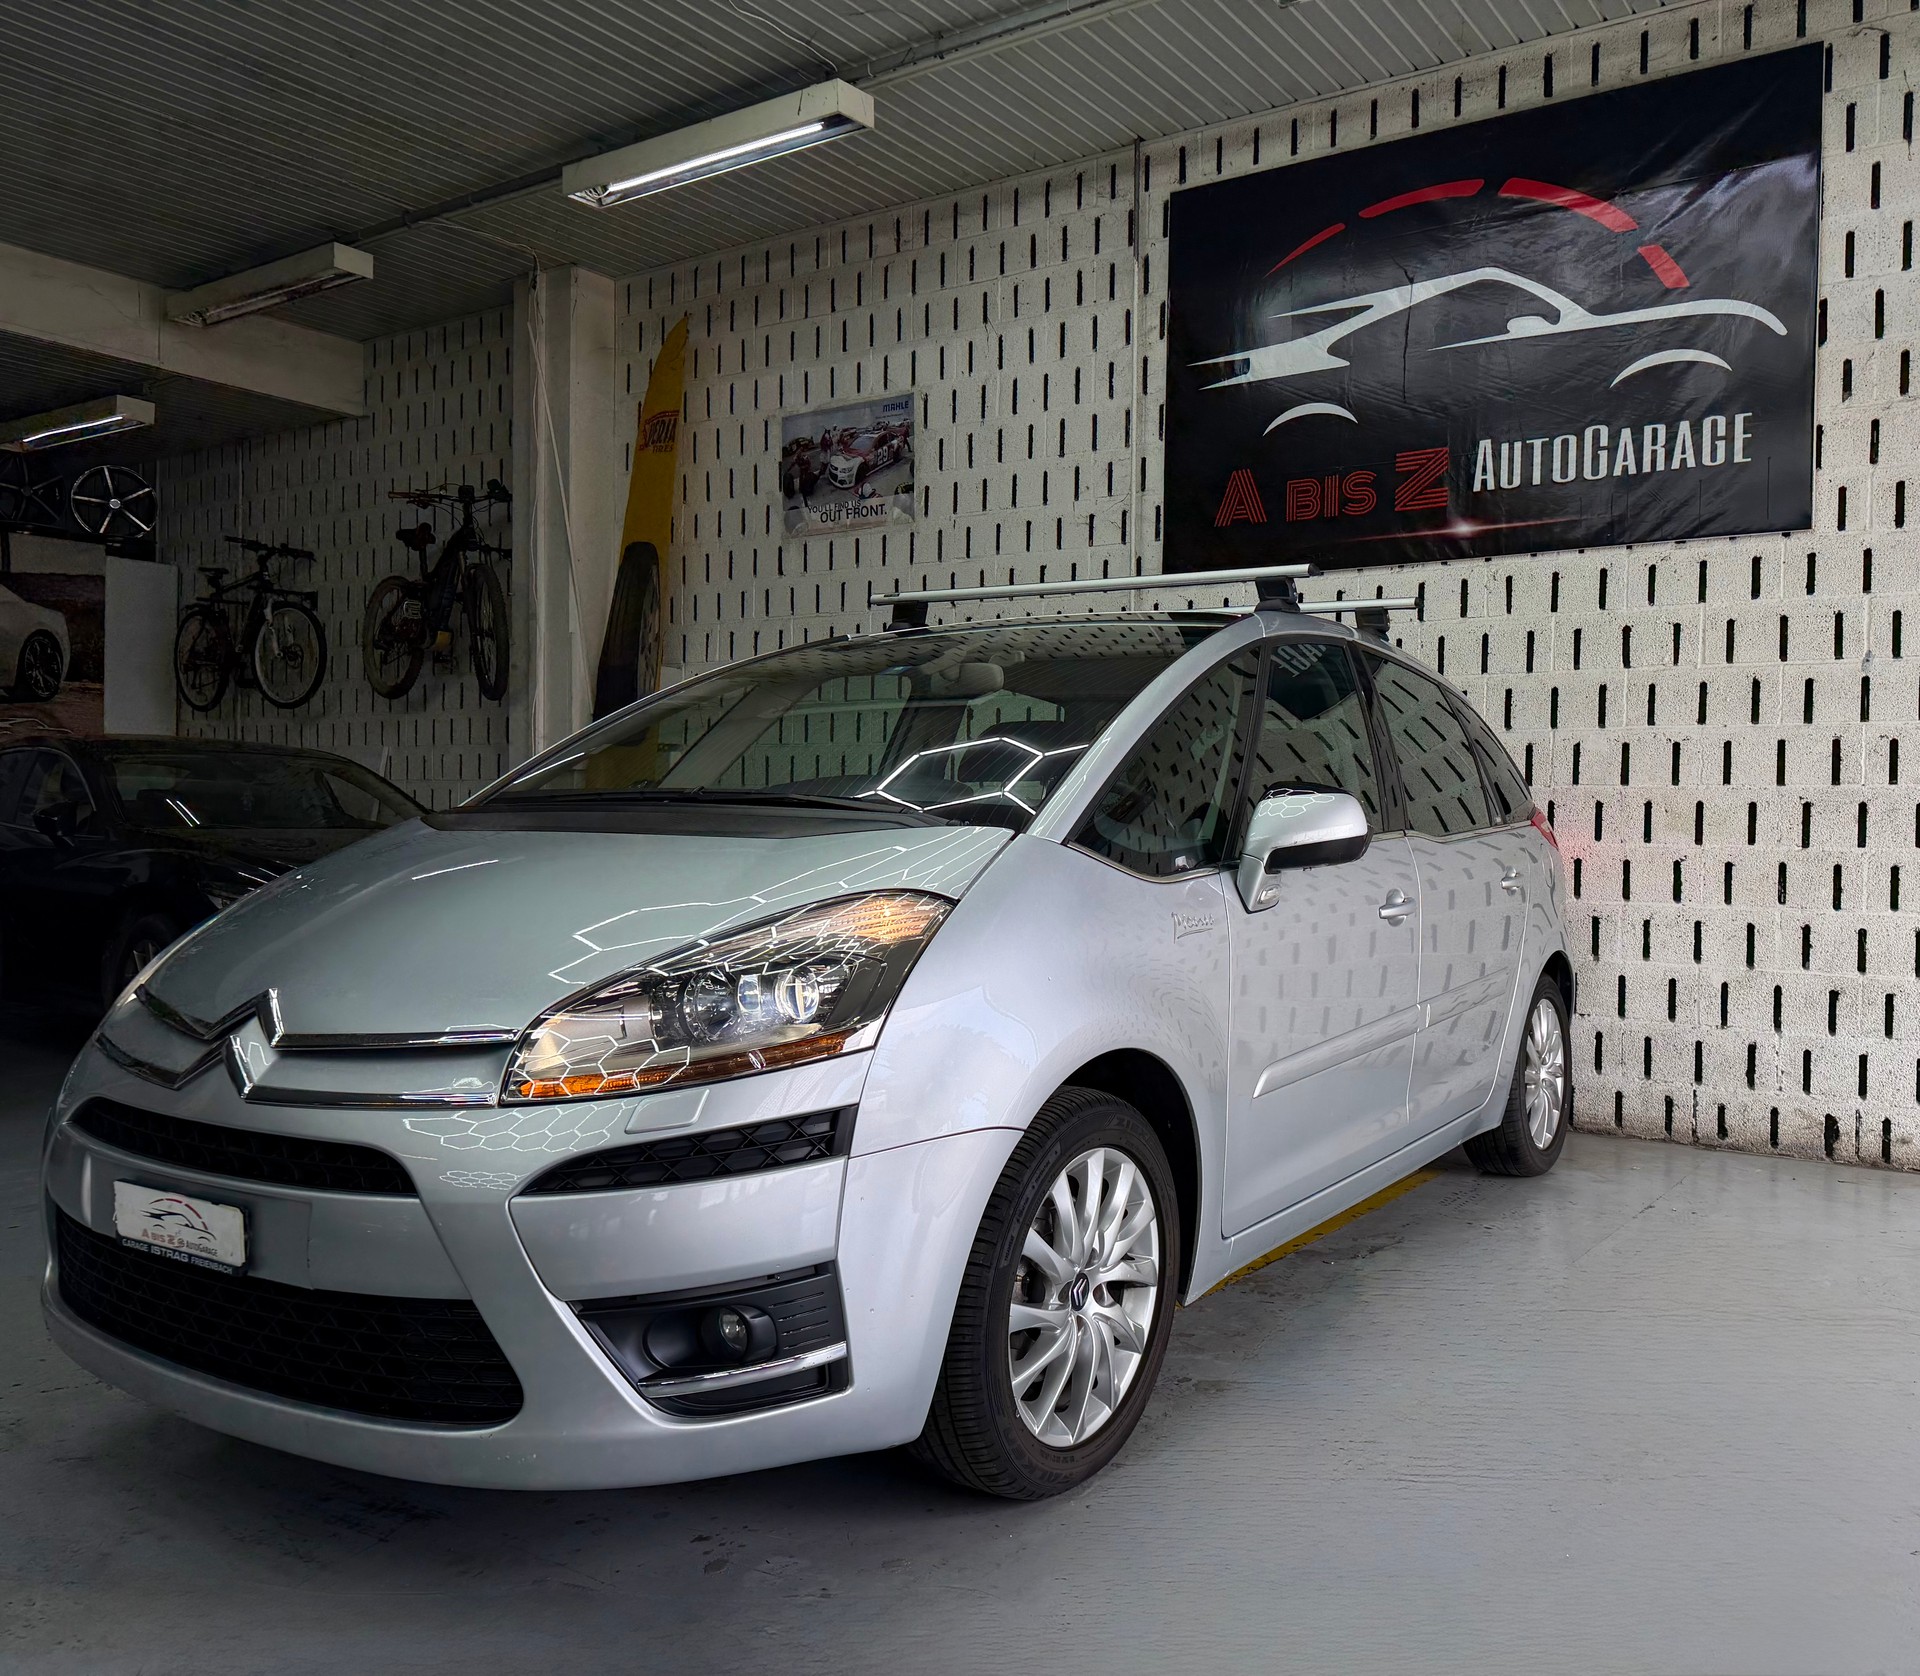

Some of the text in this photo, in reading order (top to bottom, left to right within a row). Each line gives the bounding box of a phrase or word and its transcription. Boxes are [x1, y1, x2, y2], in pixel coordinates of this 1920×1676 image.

[883, 400, 909, 413] MAHLE
[877, 446, 889, 465] 29
[1214, 412, 1753, 527] A BIS Z AUTOGARAGE
[820, 504, 887, 523] OUT FRONT.
[851, 500, 861, 508] US
[141, 1228, 150, 1239] A
[122, 1239, 149, 1252] GARAGE
[151, 1245, 189, 1262] ISTRAG
